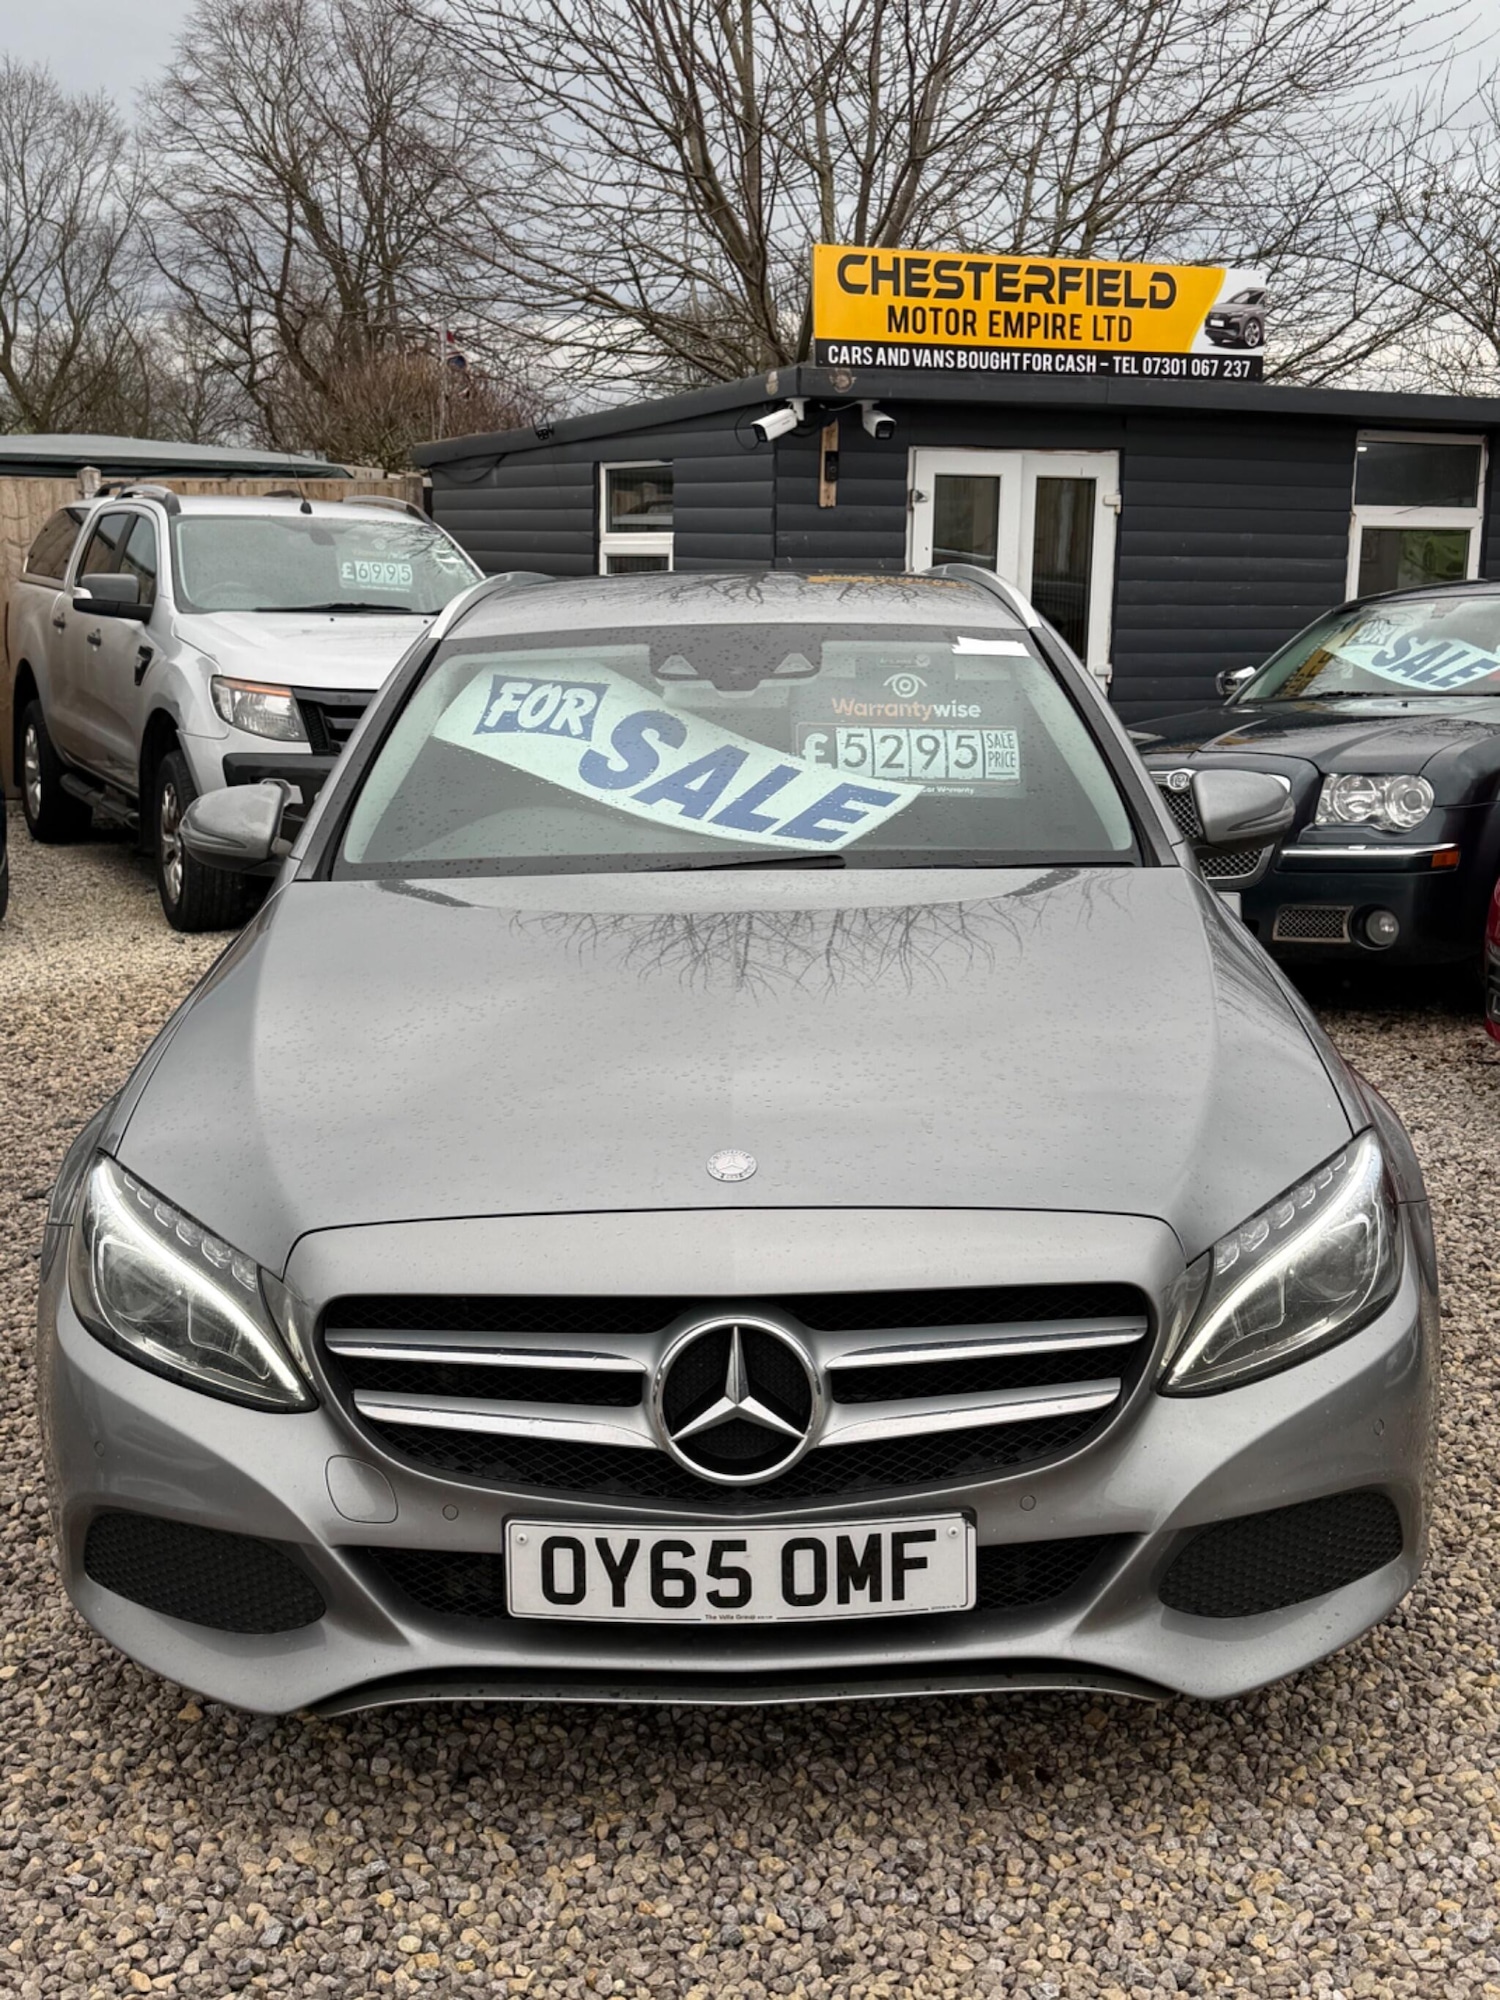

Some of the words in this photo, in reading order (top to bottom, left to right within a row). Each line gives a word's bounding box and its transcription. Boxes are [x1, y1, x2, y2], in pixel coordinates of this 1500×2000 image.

[836, 253, 1177, 310] CHESTERFIELD
[887, 305, 977, 337] MOTOR
[988, 310, 1082, 341] EMPIRE
[1091, 314, 1133, 343] LTD
[828, 345, 873, 365] CARS
[875, 346, 910, 367] AND
[912, 348, 955, 369] VANS
[957, 350, 1021, 371] BOUGHT
[1022, 353, 1053, 372] FOR
[1055, 354, 1097, 373] CASH
[1112, 355, 1139, 375] TEL
[1142, 357, 1187, 376] 07301
[1191, 359, 1219, 377] 067
[1223, 360, 1251, 378] 237
[341, 561, 411, 582] £6995
[1371, 631, 1500, 688] SALE
[831, 697, 982, 721] Warrantywise
[801, 732, 979, 770] £5295
[986, 732, 1015, 749] SALE
[987, 750, 1016, 768] PRICE
[484, 681, 597, 737] FOR
[578, 710, 901, 843] SALE
[540, 1536, 753, 1609] OY65
[781, 1528, 937, 1607] OMF
